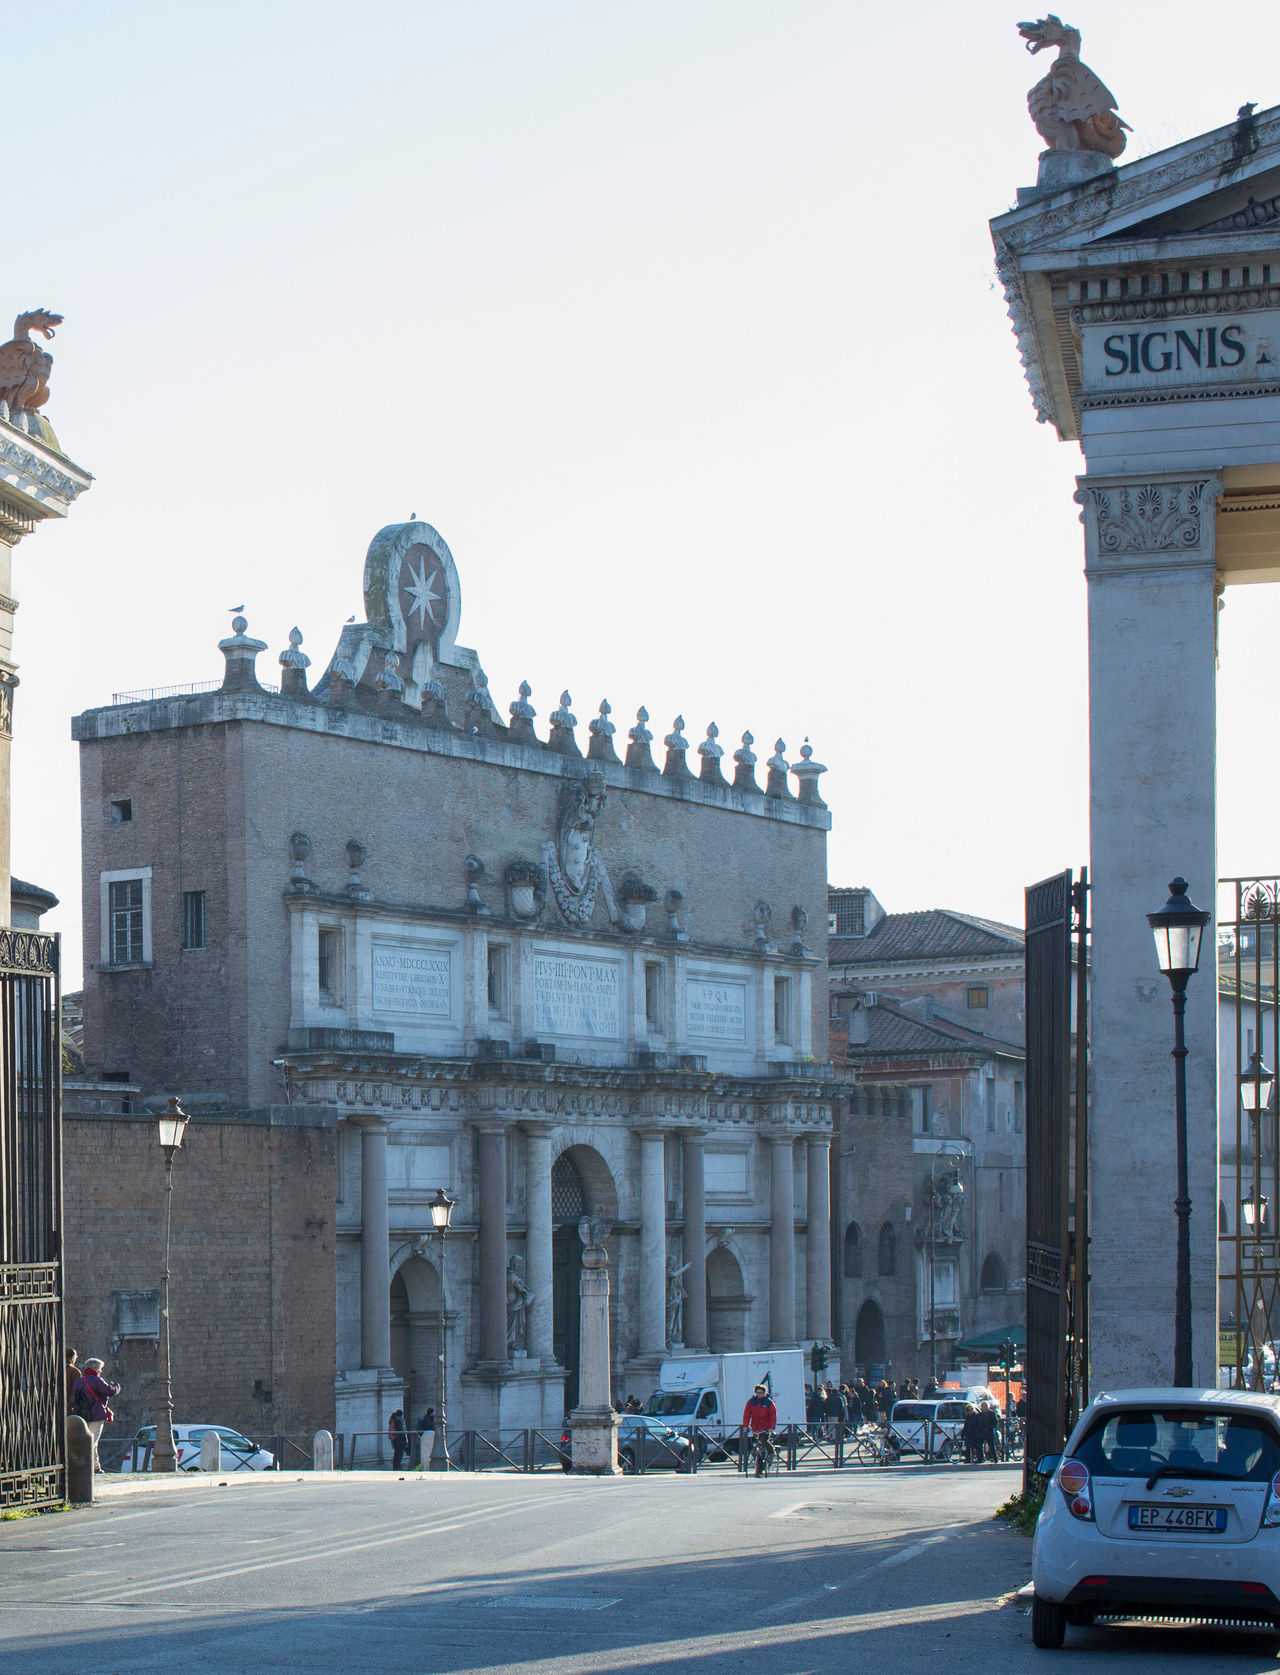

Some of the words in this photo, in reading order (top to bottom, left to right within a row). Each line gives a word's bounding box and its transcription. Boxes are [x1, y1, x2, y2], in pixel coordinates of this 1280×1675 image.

[1103, 325, 1246, 376] SIGNIS
[374, 956, 396, 967] ANNO
[534, 960, 553, 976] PIVS
[568, 964, 593, 980] PONT
[595, 967, 617, 983] MAX
[534, 977, 562, 990] PORTAM
[1140, 1508, 1159, 1524] EP
[1165, 1509, 1214, 1527] 448FK
